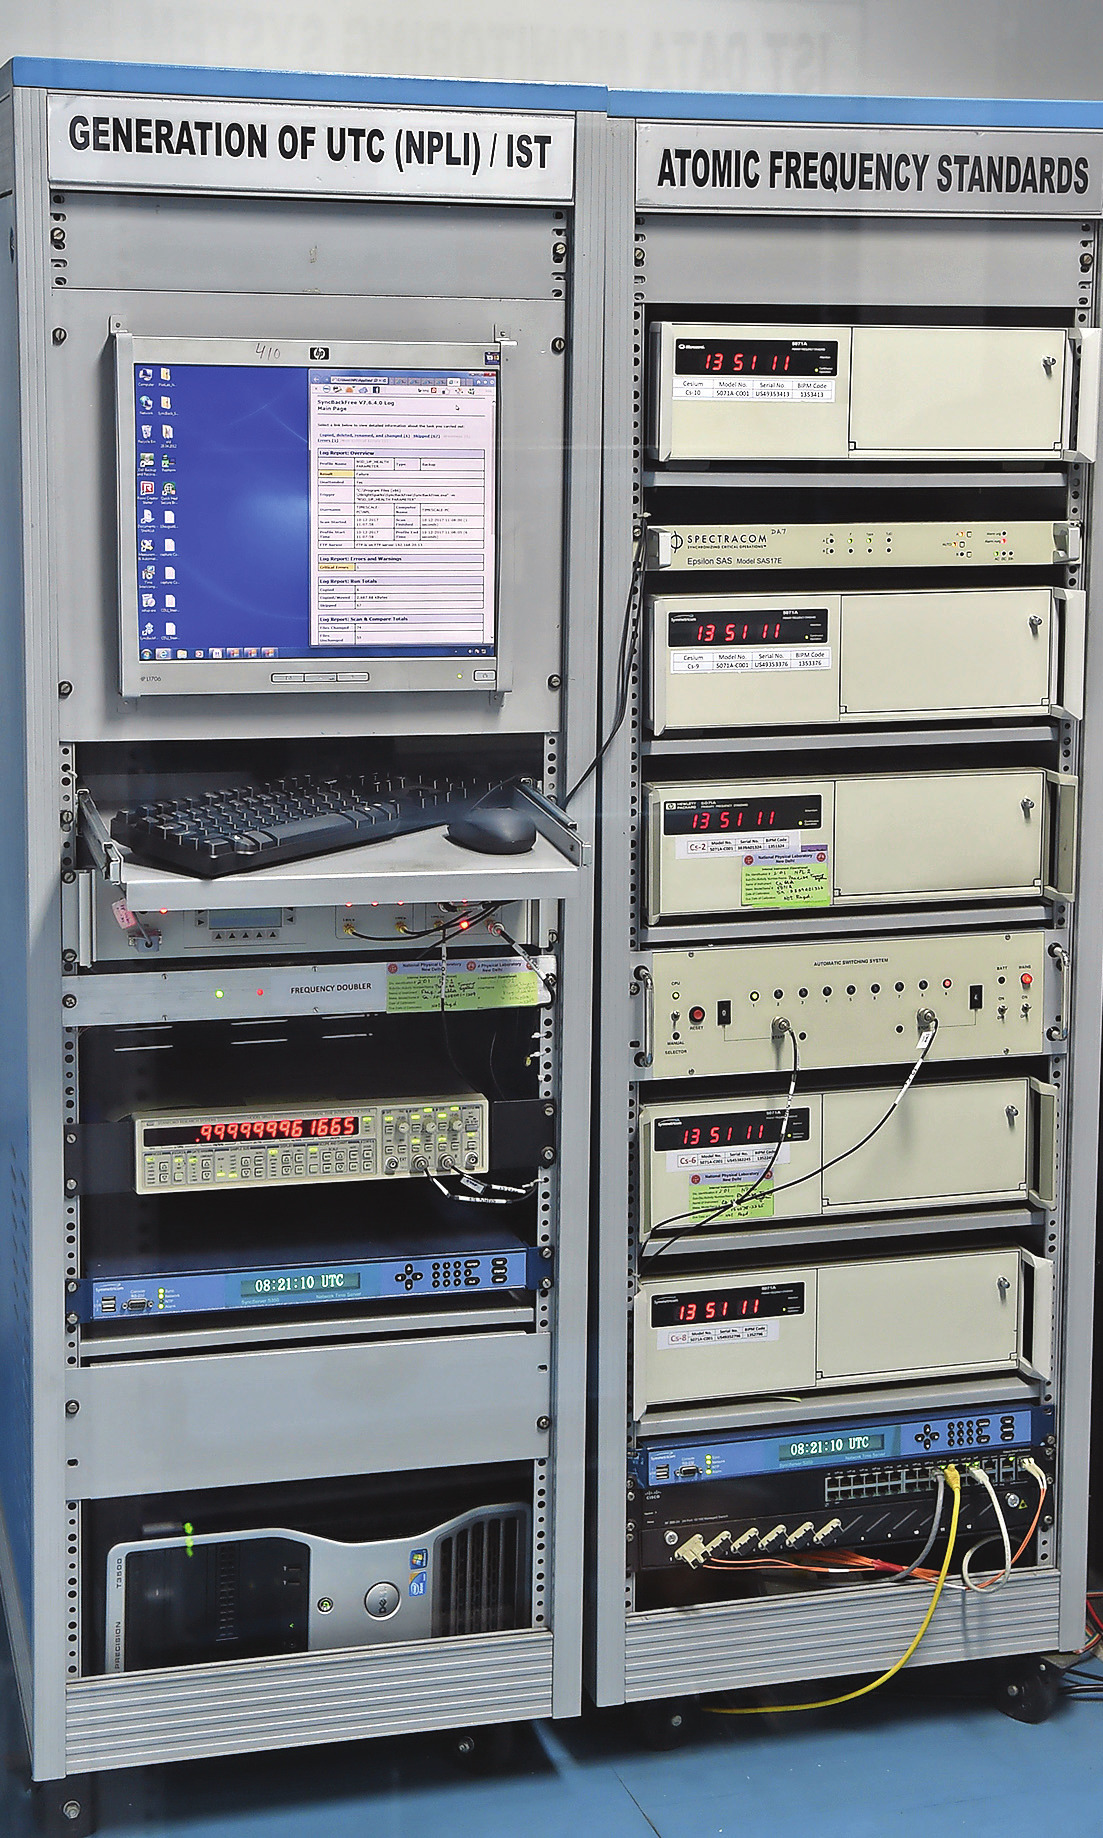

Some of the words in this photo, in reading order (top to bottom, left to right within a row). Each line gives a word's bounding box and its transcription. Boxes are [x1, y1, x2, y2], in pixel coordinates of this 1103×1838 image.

[69, 115, 267, 158] GENERATION
[278, 126, 316, 160] OF
[327, 128, 384, 164] UTC
[394, 130, 481, 175] (NPLI)
[489, 134, 498, 167] /
[507, 135, 551, 169] IST
[657, 149, 760, 188] ATOMIC
[769, 151, 930, 193] FREQUENCY
[936, 155, 1089, 194] STANDARDS
[704, 353, 724, 371] 13
[733, 353, 757, 371] 51
[771, 355, 790, 371] 11
[687, 533, 768, 544] SPECTRACOM
[687, 557, 714, 566] Epsilon
[715, 556, 733, 565] SAS
[736, 557, 755, 566] Model
[756, 556, 782, 565] SAS17E
[696, 624, 716, 641] 13
[724, 623, 748, 641] 51
[761, 623, 781, 639] 11
[691, 812, 711, 830] 13
[719, 812, 743, 829] 51
[757, 811, 776, 825] 11
[689, 843, 706, 852] Cs-2
[291, 985, 336, 994] FREQUENCY
[336, 982, 372, 991] DOUBLER
[683, 1128, 701, 1145] 13
[709, 1126, 733, 1144] 51
[746, 1124, 764, 1140] 11
[679, 1157, 697, 1165] Cs-6
[255, 1275, 315, 1293] 08:21:10
[321, 1273, 344, 1287] UTC
[679, 1304, 697, 1321] 13
[705, 1301, 728, 1319] 51
[741, 1299, 760, 1315] 11
[670, 1334, 687, 1342] Cs-8
[790, 1438, 844, 1460] 08:21:10
[848, 1436, 869, 1450] UTC
